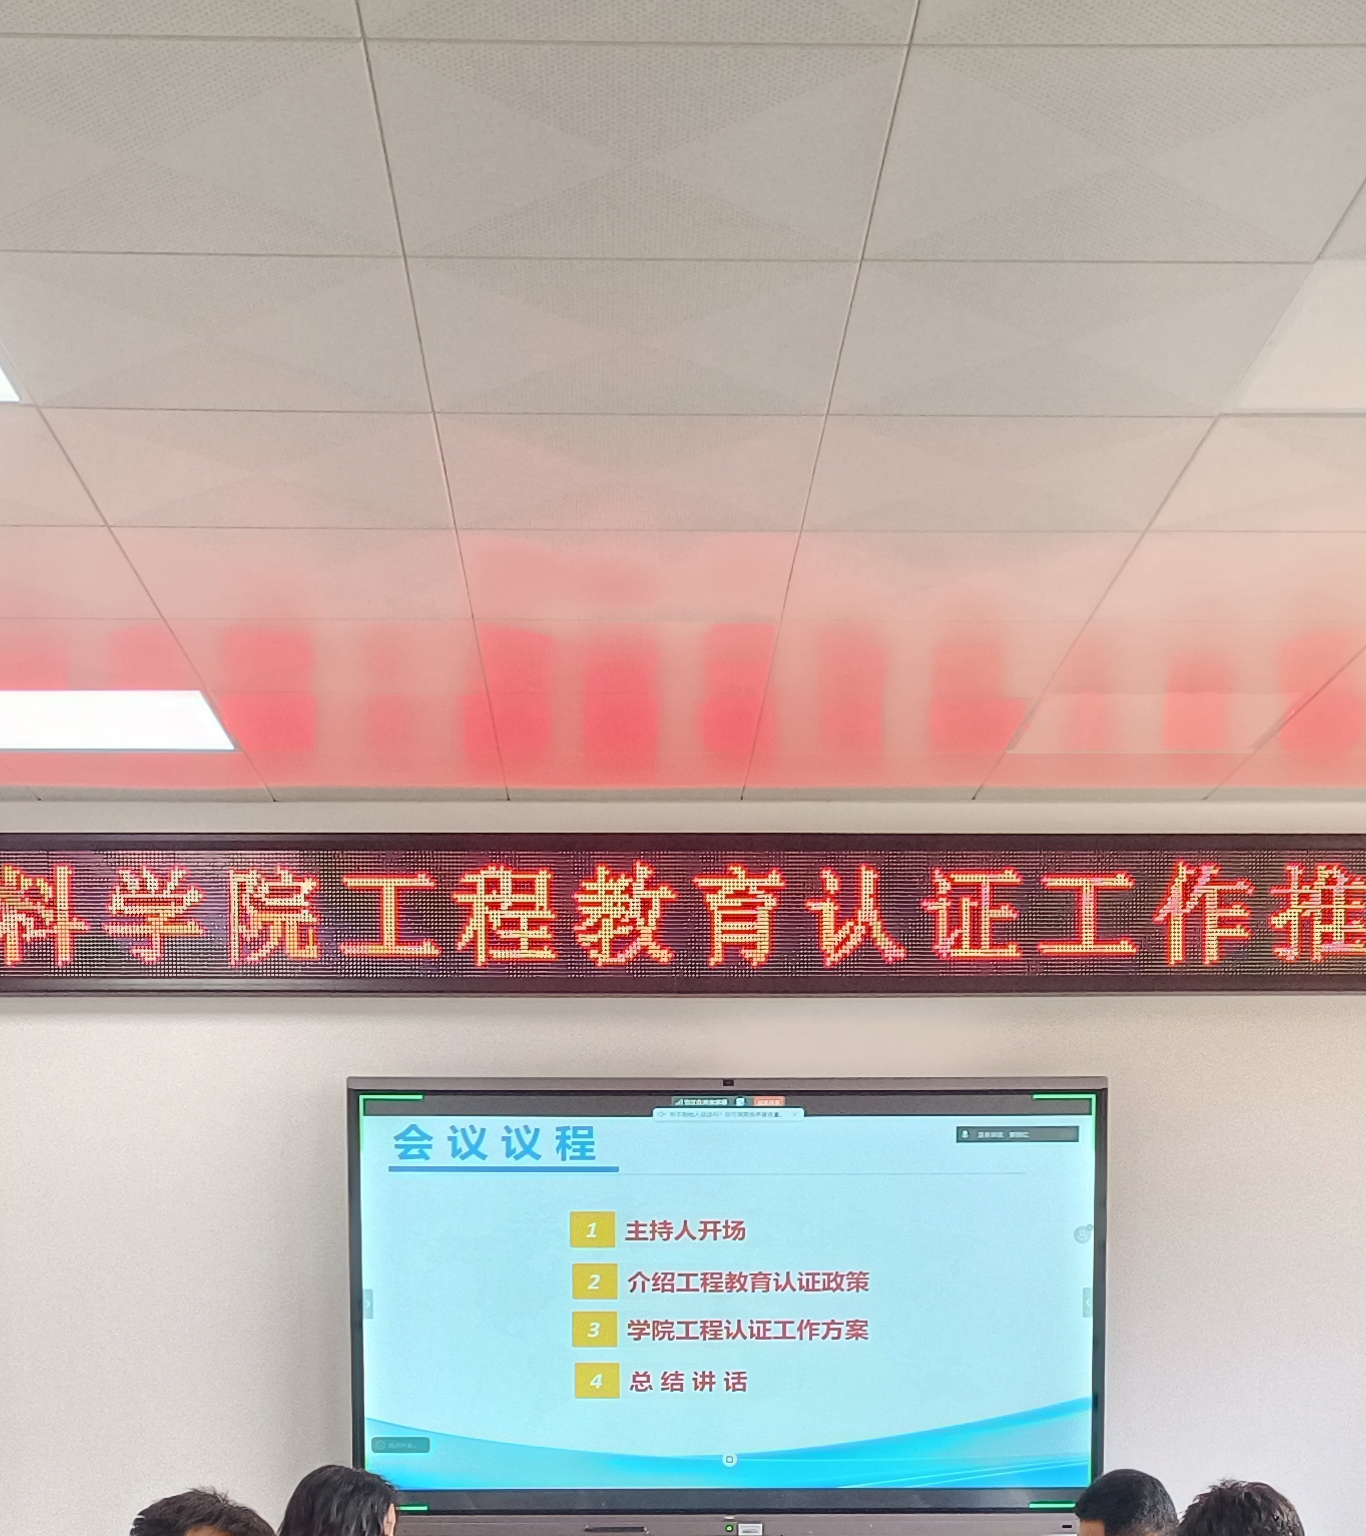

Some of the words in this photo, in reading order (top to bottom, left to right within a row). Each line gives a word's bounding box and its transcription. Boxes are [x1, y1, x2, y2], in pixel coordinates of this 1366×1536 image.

[393, 1123, 596, 1161] 会议议程
[585, 1222, 597, 1238] 1
[625, 1220, 746, 1241] 主持人开场
[587, 1274, 600, 1290] 2
[627, 1271, 869, 1293] 介绍工程教育认证政策
[587, 1322, 600, 1338] 3
[627, 1319, 869, 1341] 学院工程认证工作方案
[590, 1373, 603, 1390] 4
[629, 1371, 747, 1392] 总结讲话
